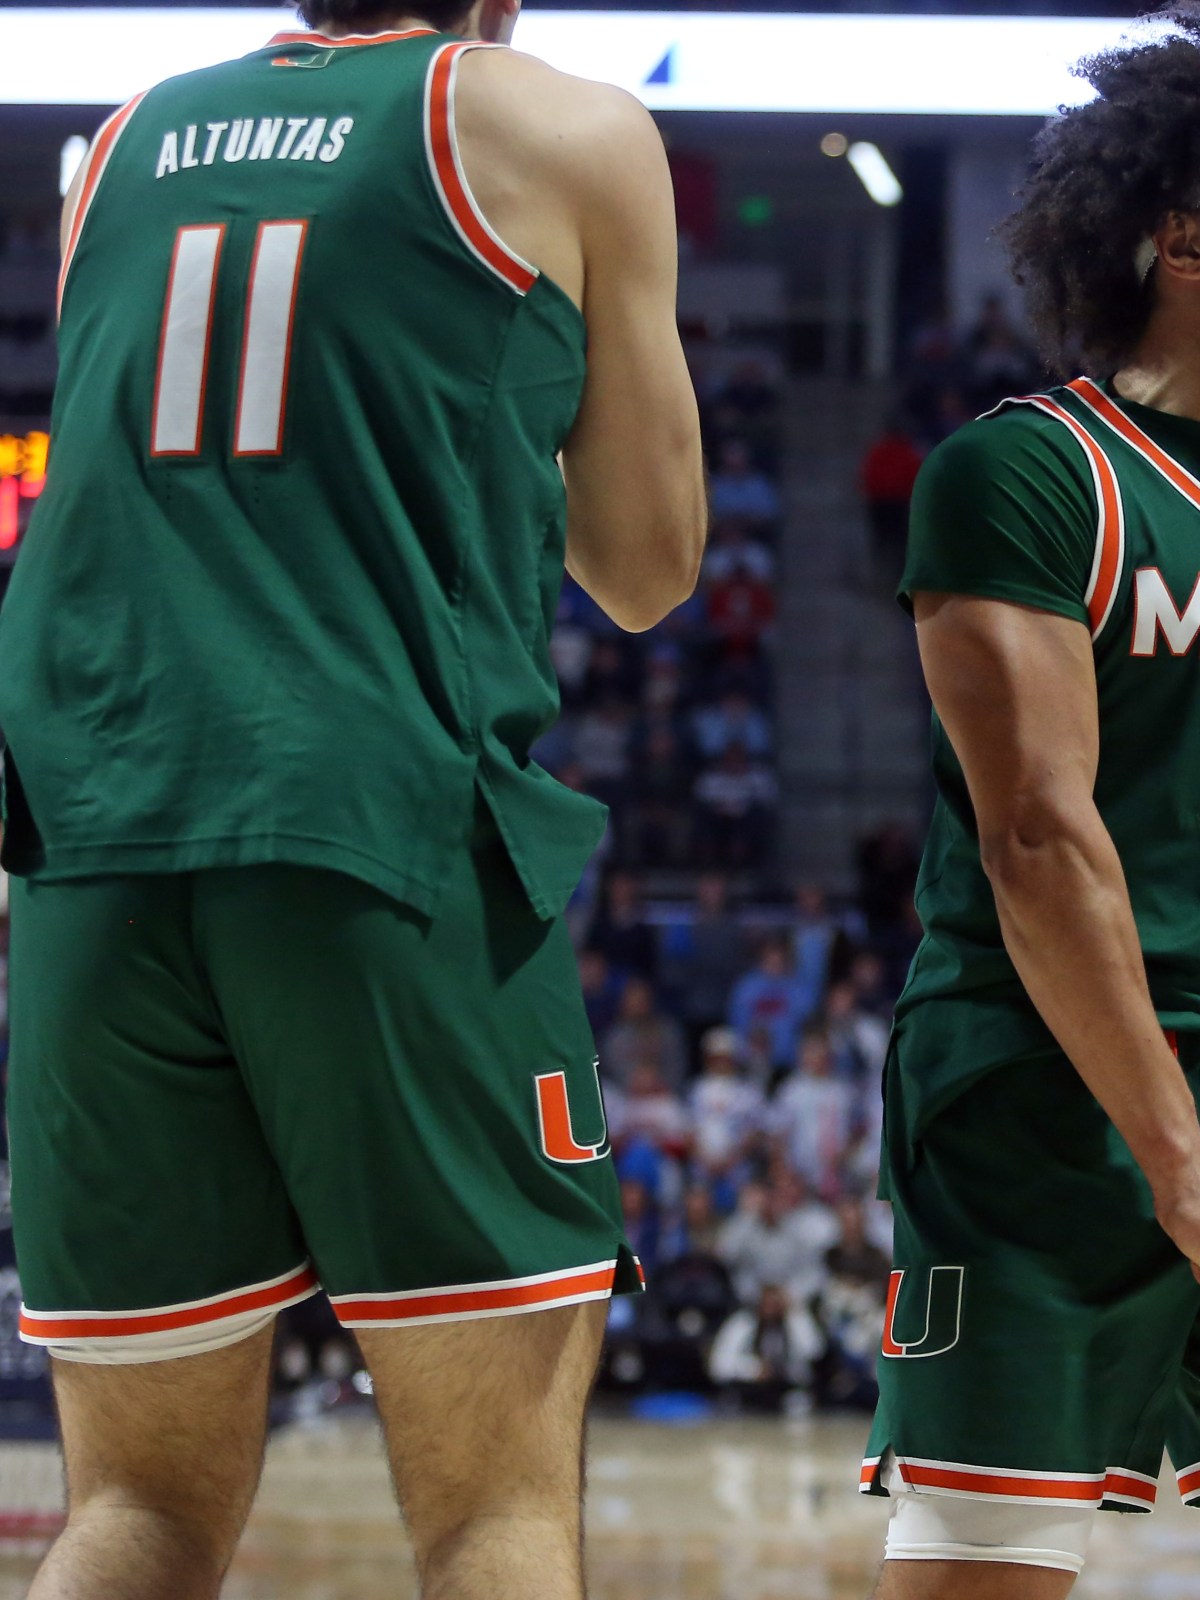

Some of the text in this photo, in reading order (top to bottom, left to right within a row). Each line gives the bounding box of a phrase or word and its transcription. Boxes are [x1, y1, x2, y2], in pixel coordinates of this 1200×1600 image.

[155, 116, 355, 178] ALTUNTAS
[149, 219, 309, 459] 11
[534, 1060, 612, 1164] U
[881, 1265, 964, 1358] U
